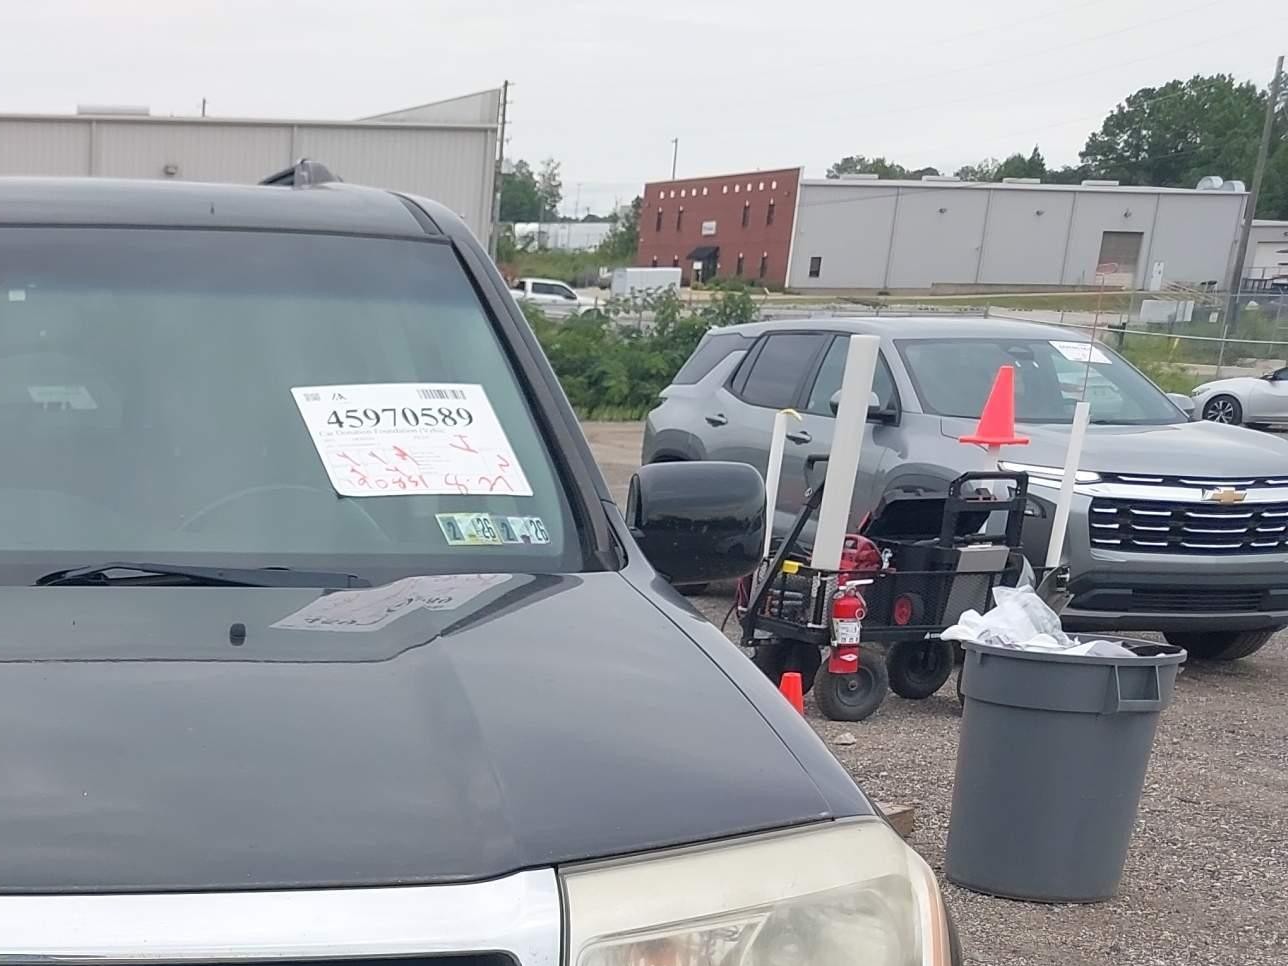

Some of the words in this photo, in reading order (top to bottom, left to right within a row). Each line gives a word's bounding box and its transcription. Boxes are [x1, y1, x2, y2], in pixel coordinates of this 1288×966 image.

[327, 407, 473, 428] 45970589
[476, 517, 496, 539] 26
[529, 519, 549, 542] 26
